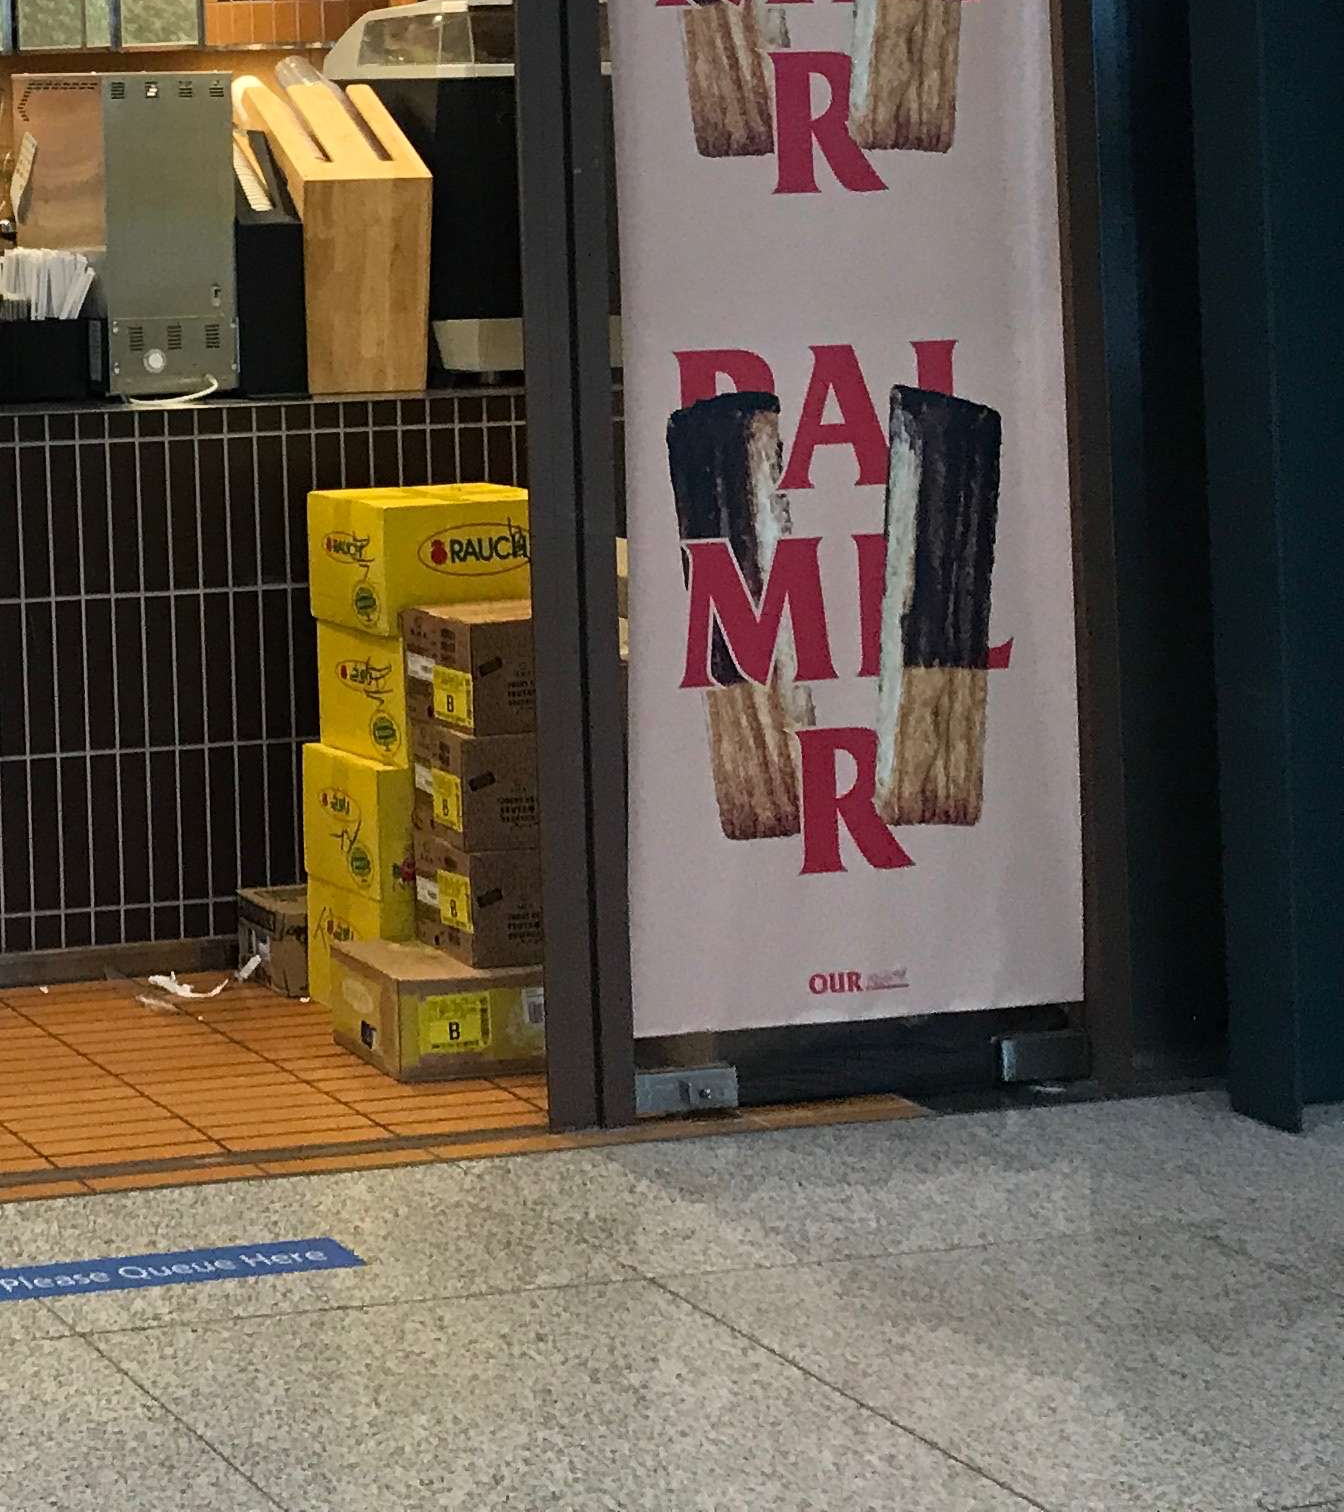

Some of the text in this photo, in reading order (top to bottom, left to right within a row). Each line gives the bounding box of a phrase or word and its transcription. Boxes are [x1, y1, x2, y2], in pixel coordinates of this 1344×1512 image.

[808, 971, 864, 995] OUR
[448, 1021, 461, 1041] B
[118, 1258, 237, 1281] Queue
[239, 1251, 328, 1268] Here
